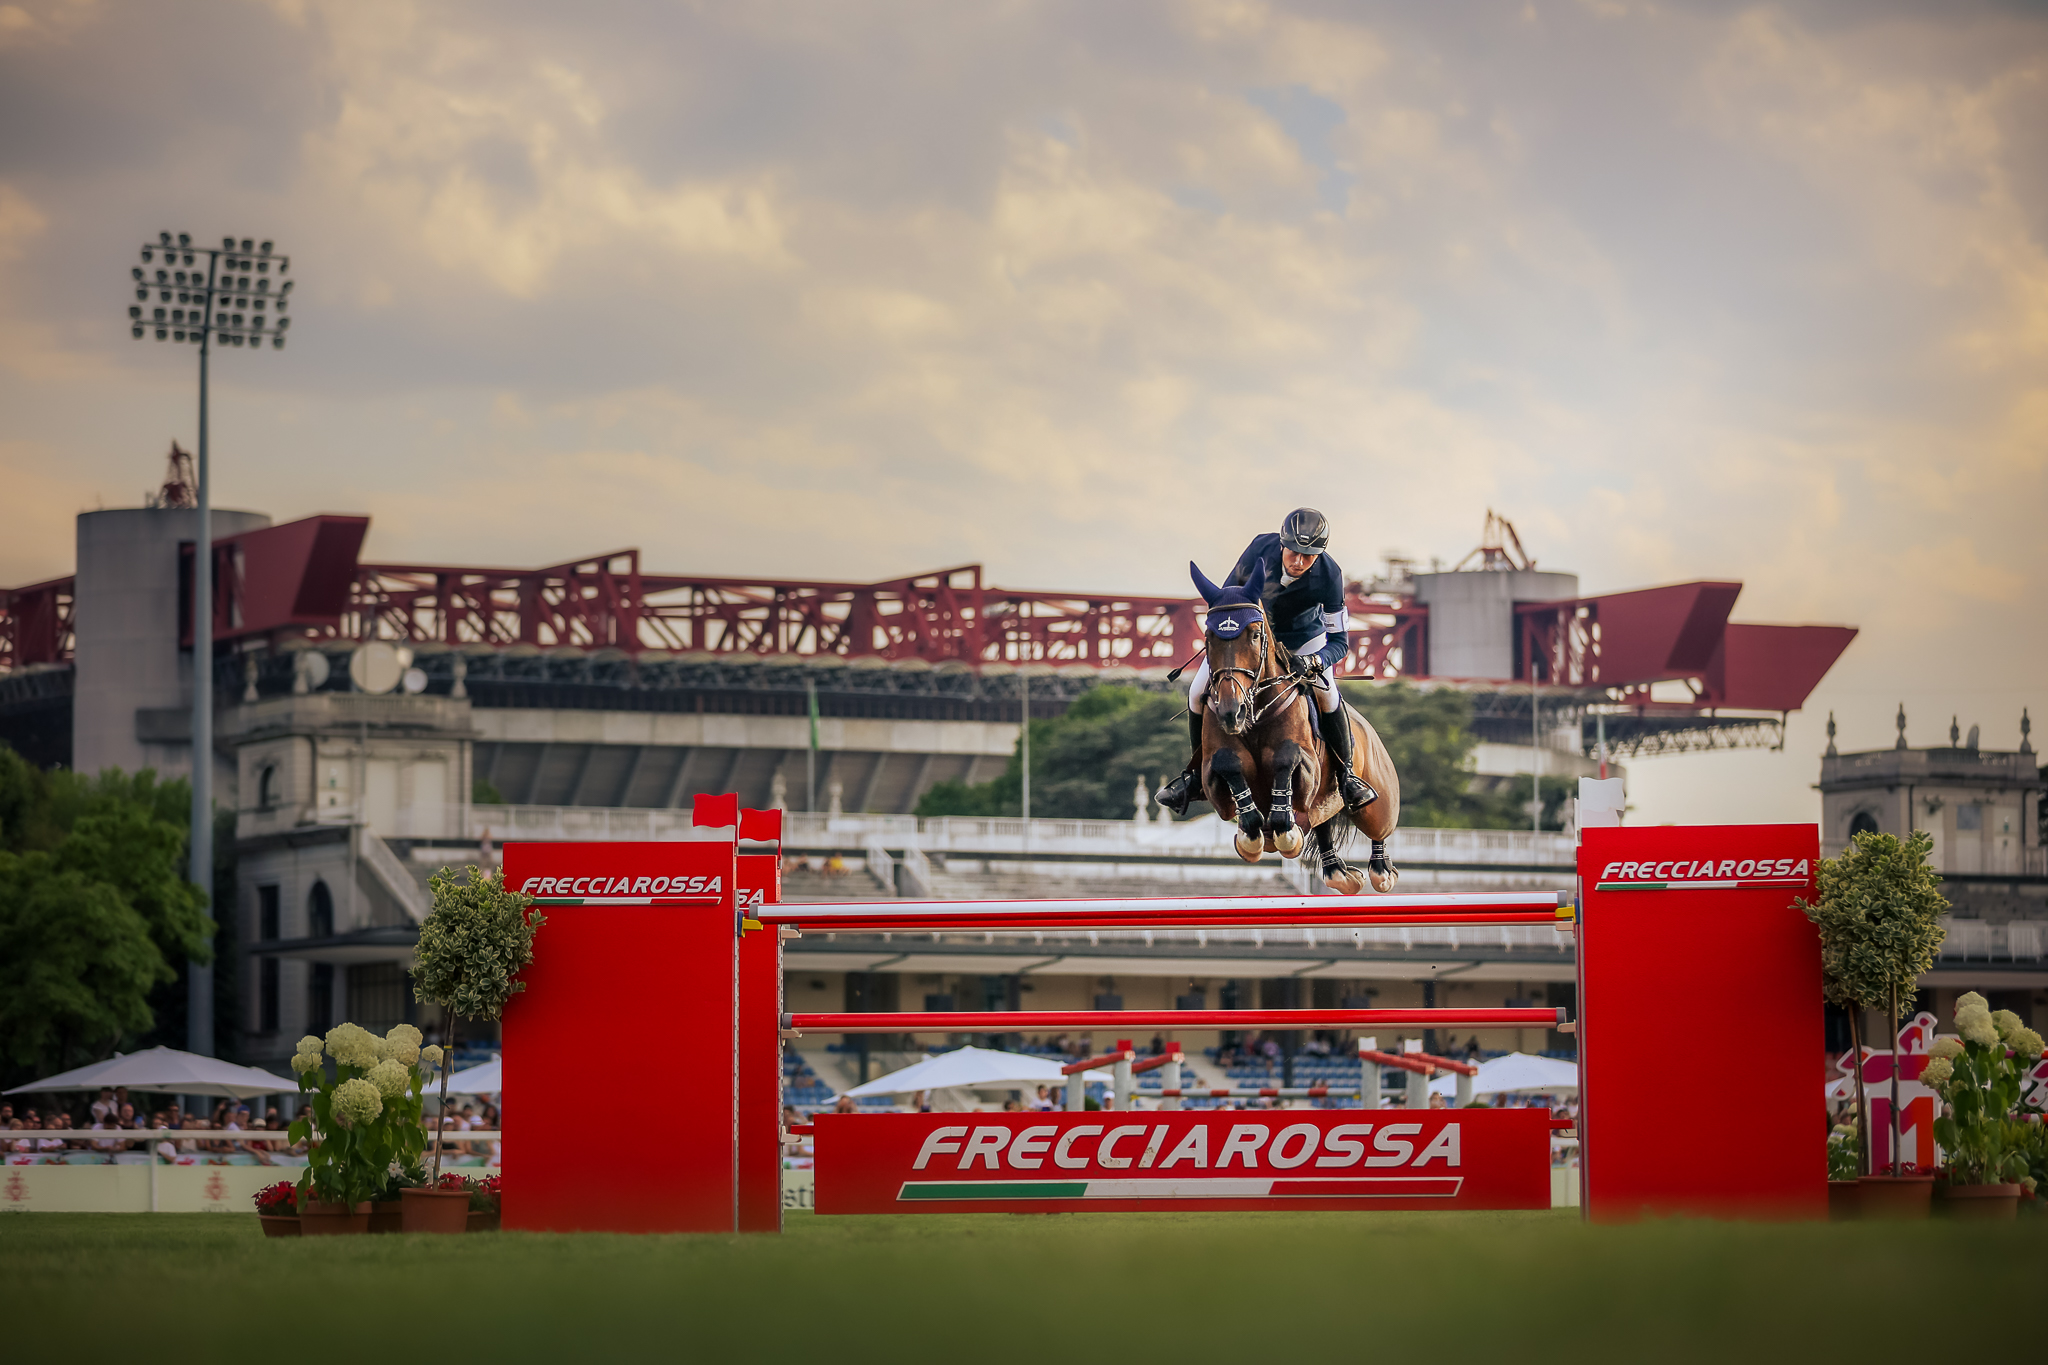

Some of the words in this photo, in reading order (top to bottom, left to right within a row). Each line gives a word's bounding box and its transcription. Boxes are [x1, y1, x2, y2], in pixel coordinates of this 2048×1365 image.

[1600, 858, 1809, 880] FRECCIAROSSA
[520, 876, 722, 894] FRECCIAROSSA
[912, 1122, 1461, 1170] FRECCIAROSSA
